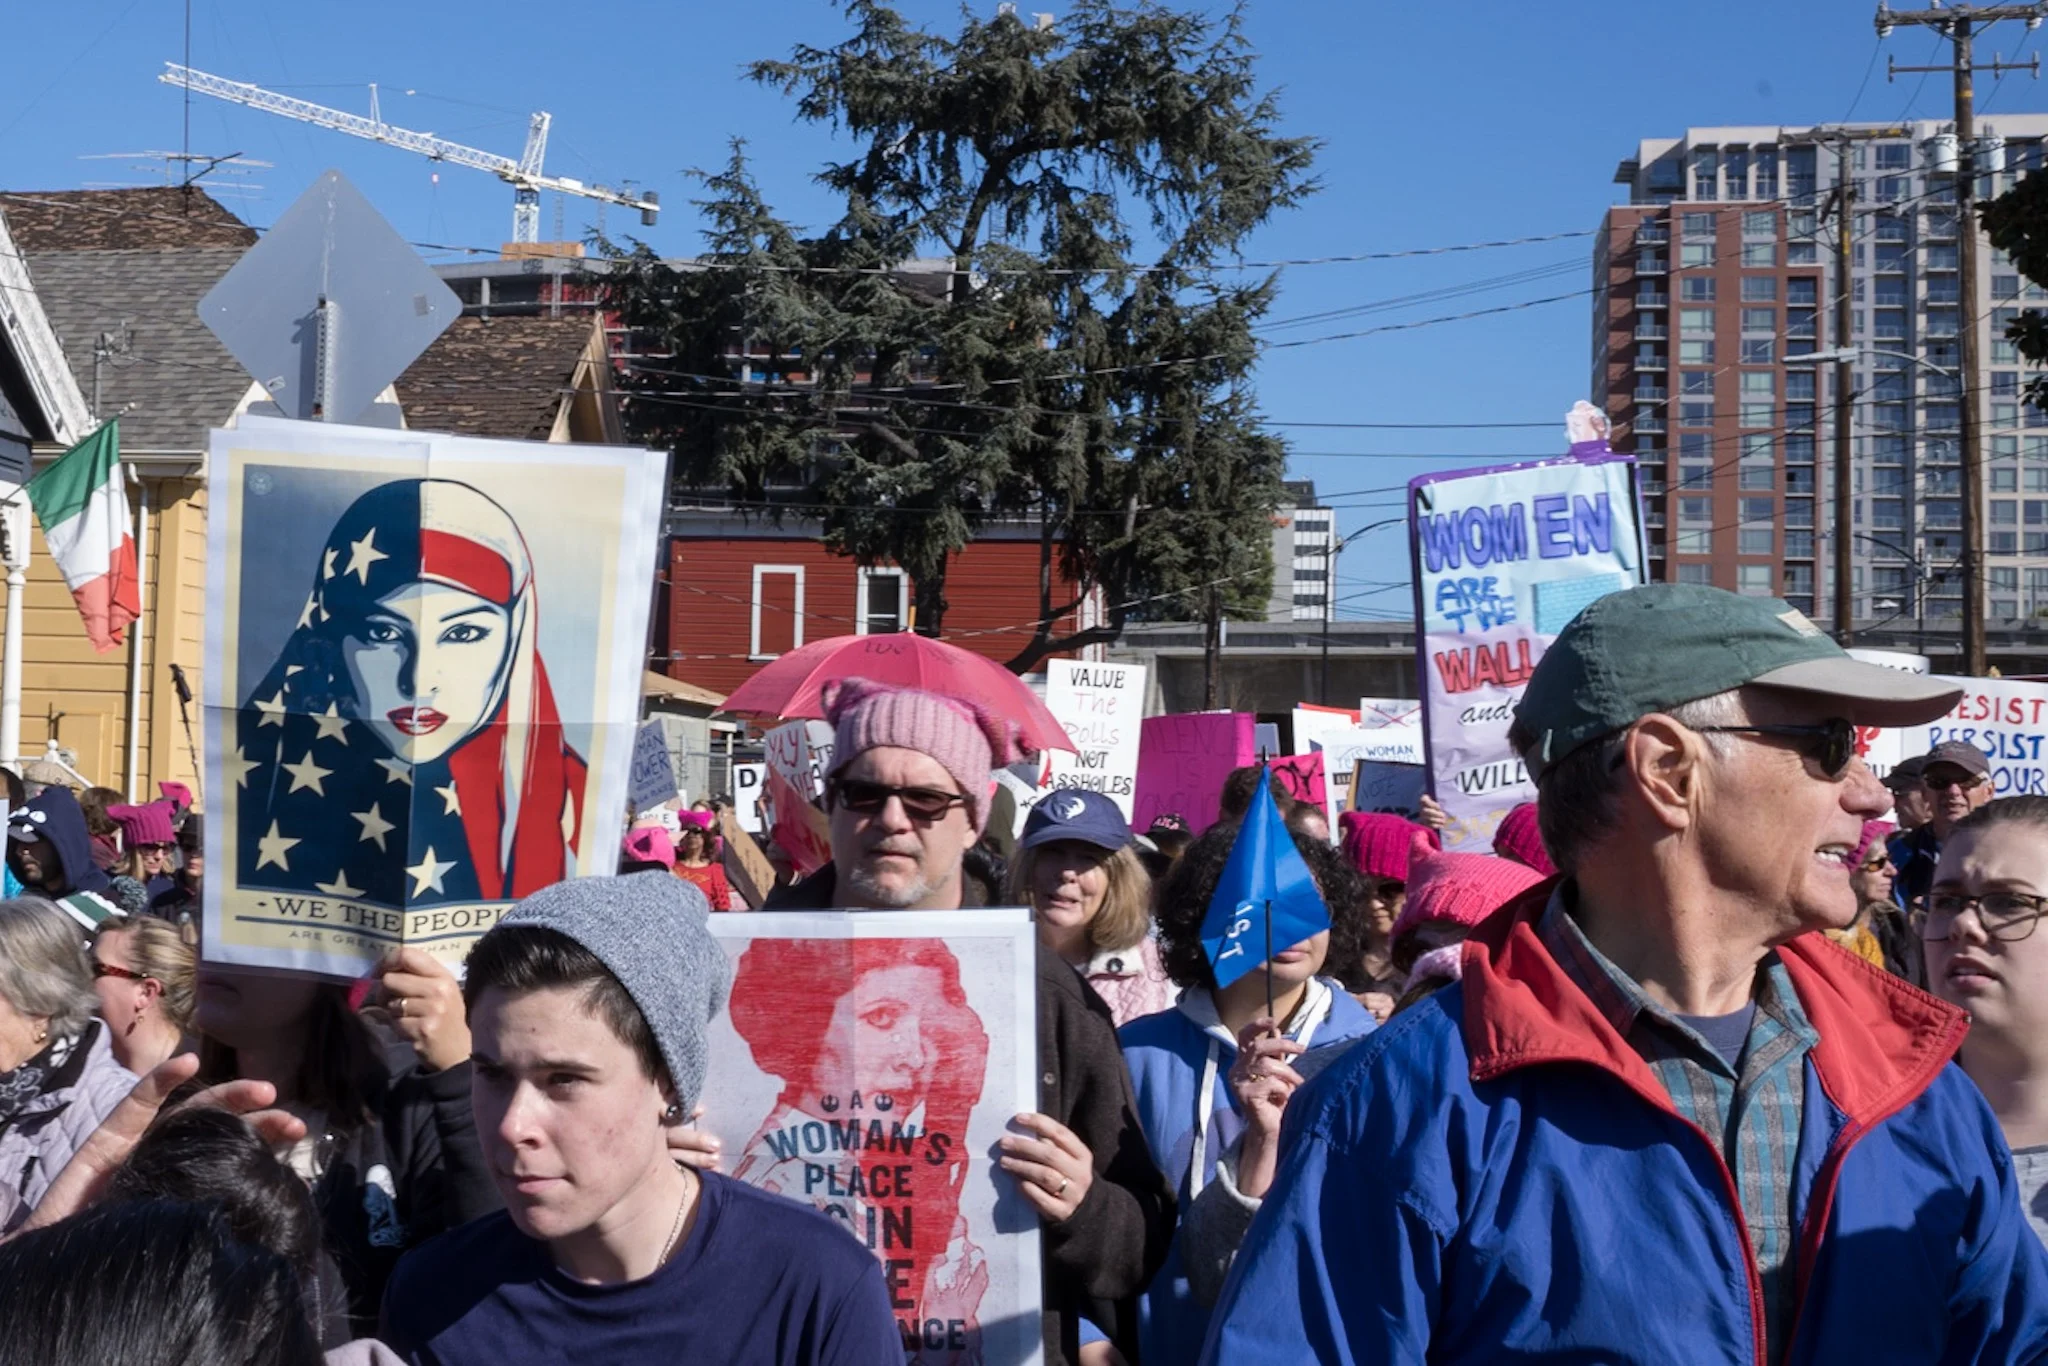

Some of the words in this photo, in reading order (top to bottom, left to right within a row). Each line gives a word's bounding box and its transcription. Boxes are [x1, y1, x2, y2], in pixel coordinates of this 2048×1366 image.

[1418, 493, 1613, 573] WOMEN
[1435, 576, 1500, 612] ARE
[1443, 596, 1518, 634] THE
[1070, 667, 1126, 689] VALUE
[1434, 638, 1536, 694] WALL
[1074, 692, 1117, 715] The
[1460, 697, 1515, 723] and
[1946, 693, 2047, 725] ESIST
[1075, 750, 1109, 769] NOT
[1365, 744, 1414, 757] WOMAN
[1045, 772, 1133, 796] ASSHOLES
[1460, 759, 1527, 793] WILL
[273, 897, 328, 919] WE
[339, 904, 402, 933] THE
[411, 908, 503, 934] PEOP
[1218, 903, 1254, 961] IST
[288, 929, 322, 941] ARE
[849, 1089, 864, 1110] A
[763, 1119, 952, 1166] WOMAN'S
[804, 1163, 914, 1198] PLACE
[865, 1206, 914, 1250] IN
